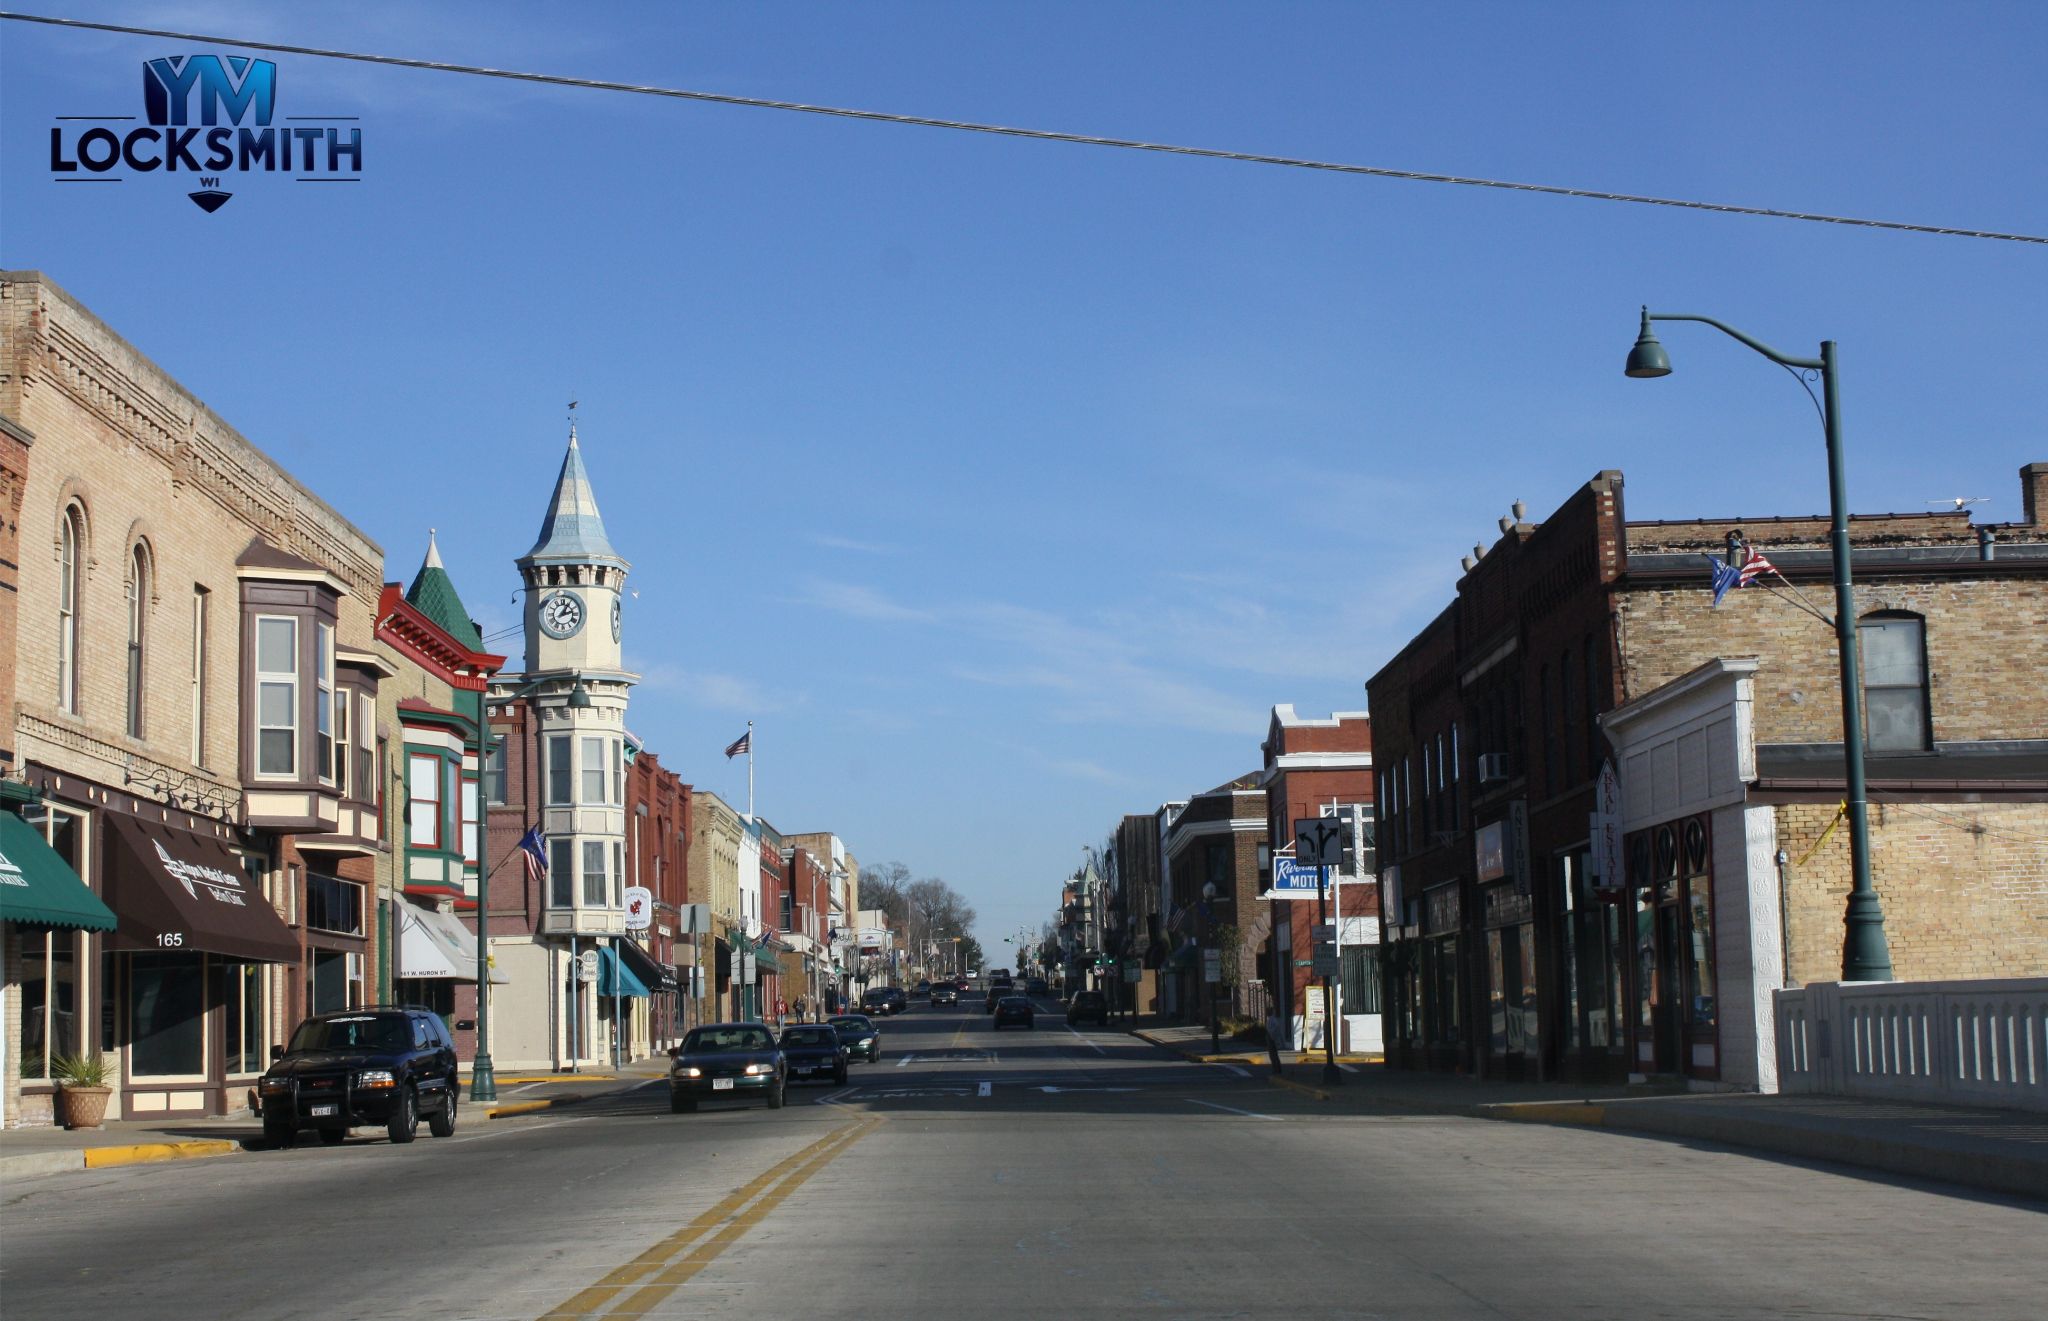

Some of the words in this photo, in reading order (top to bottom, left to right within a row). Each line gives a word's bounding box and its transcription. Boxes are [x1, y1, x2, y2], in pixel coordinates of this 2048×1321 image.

[1603, 772, 1614, 815] REAL
[1298, 855, 1316, 864] ONLY
[1514, 805, 1526, 894] ANTIQUES
[1605, 823, 1617, 886] ESTATE
[156, 933, 183, 947] 165
